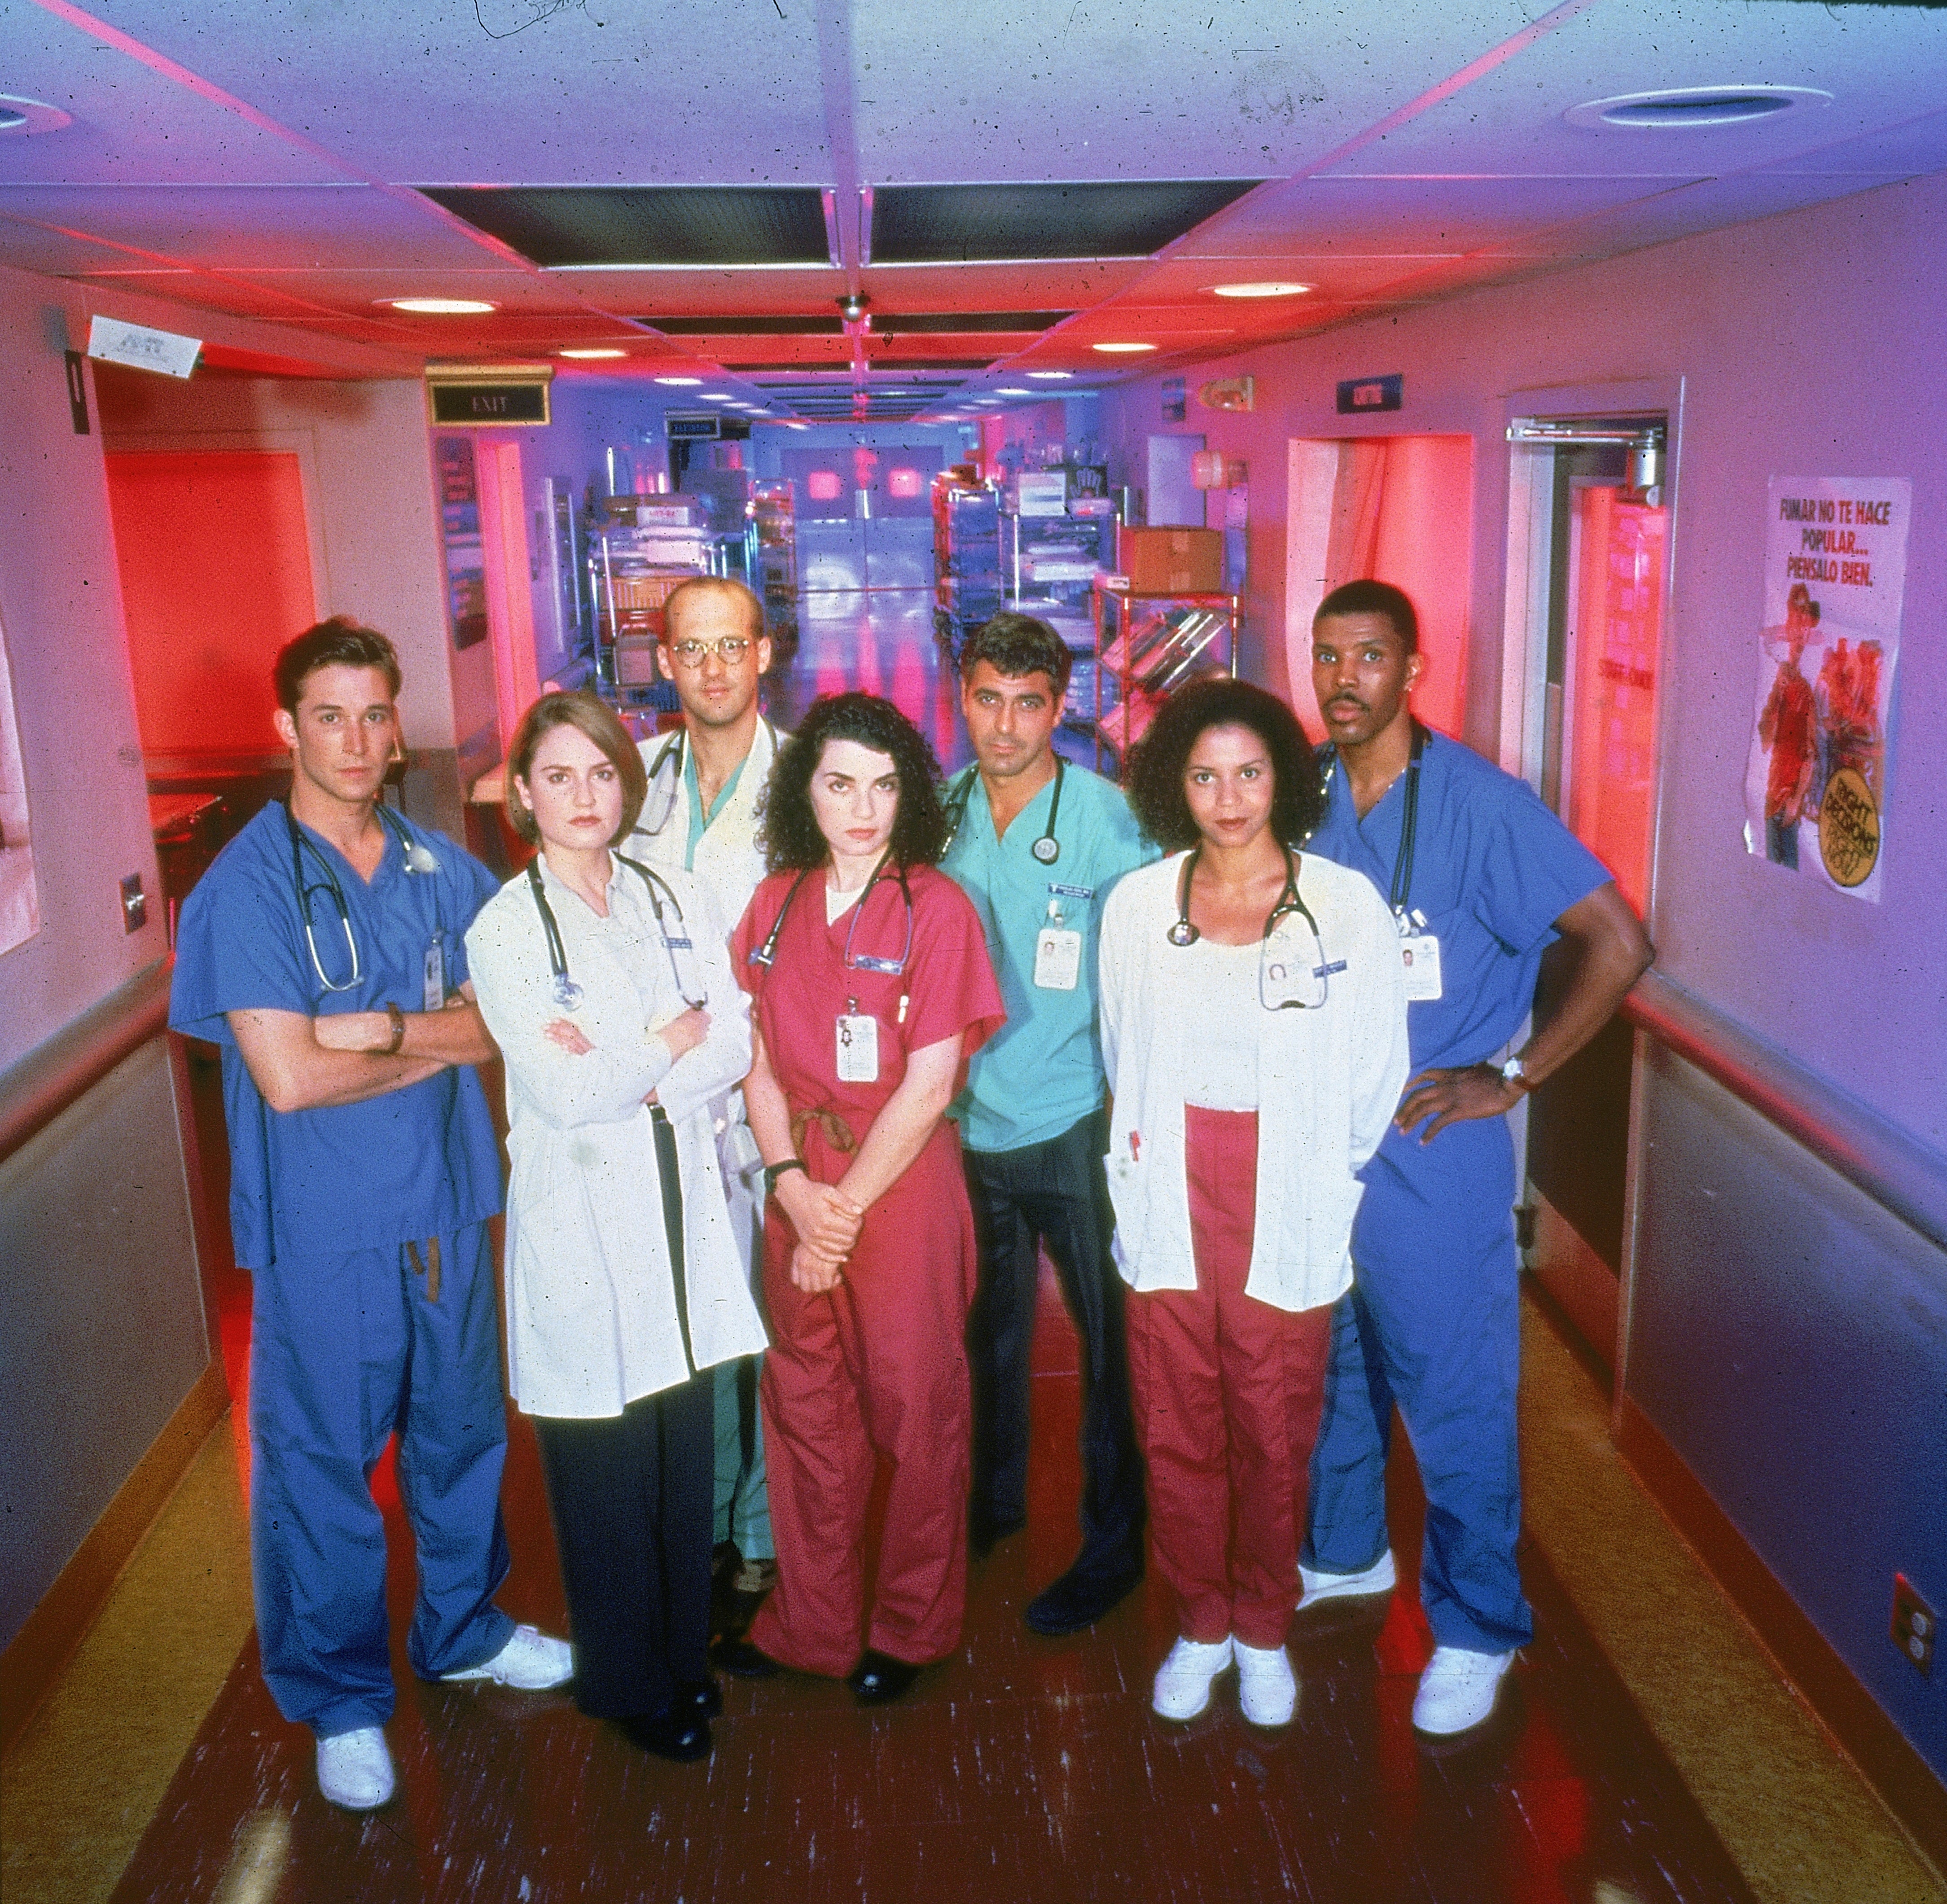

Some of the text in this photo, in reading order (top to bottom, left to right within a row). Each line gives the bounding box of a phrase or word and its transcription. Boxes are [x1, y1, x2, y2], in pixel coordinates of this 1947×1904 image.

[473, 397, 508, 412] EXIT
[1780, 498, 1891, 525] FUMAR NO TE HACE
[1802, 528, 1868, 555] POPULAR...
[1842, 561, 1873, 587] BIEN.
